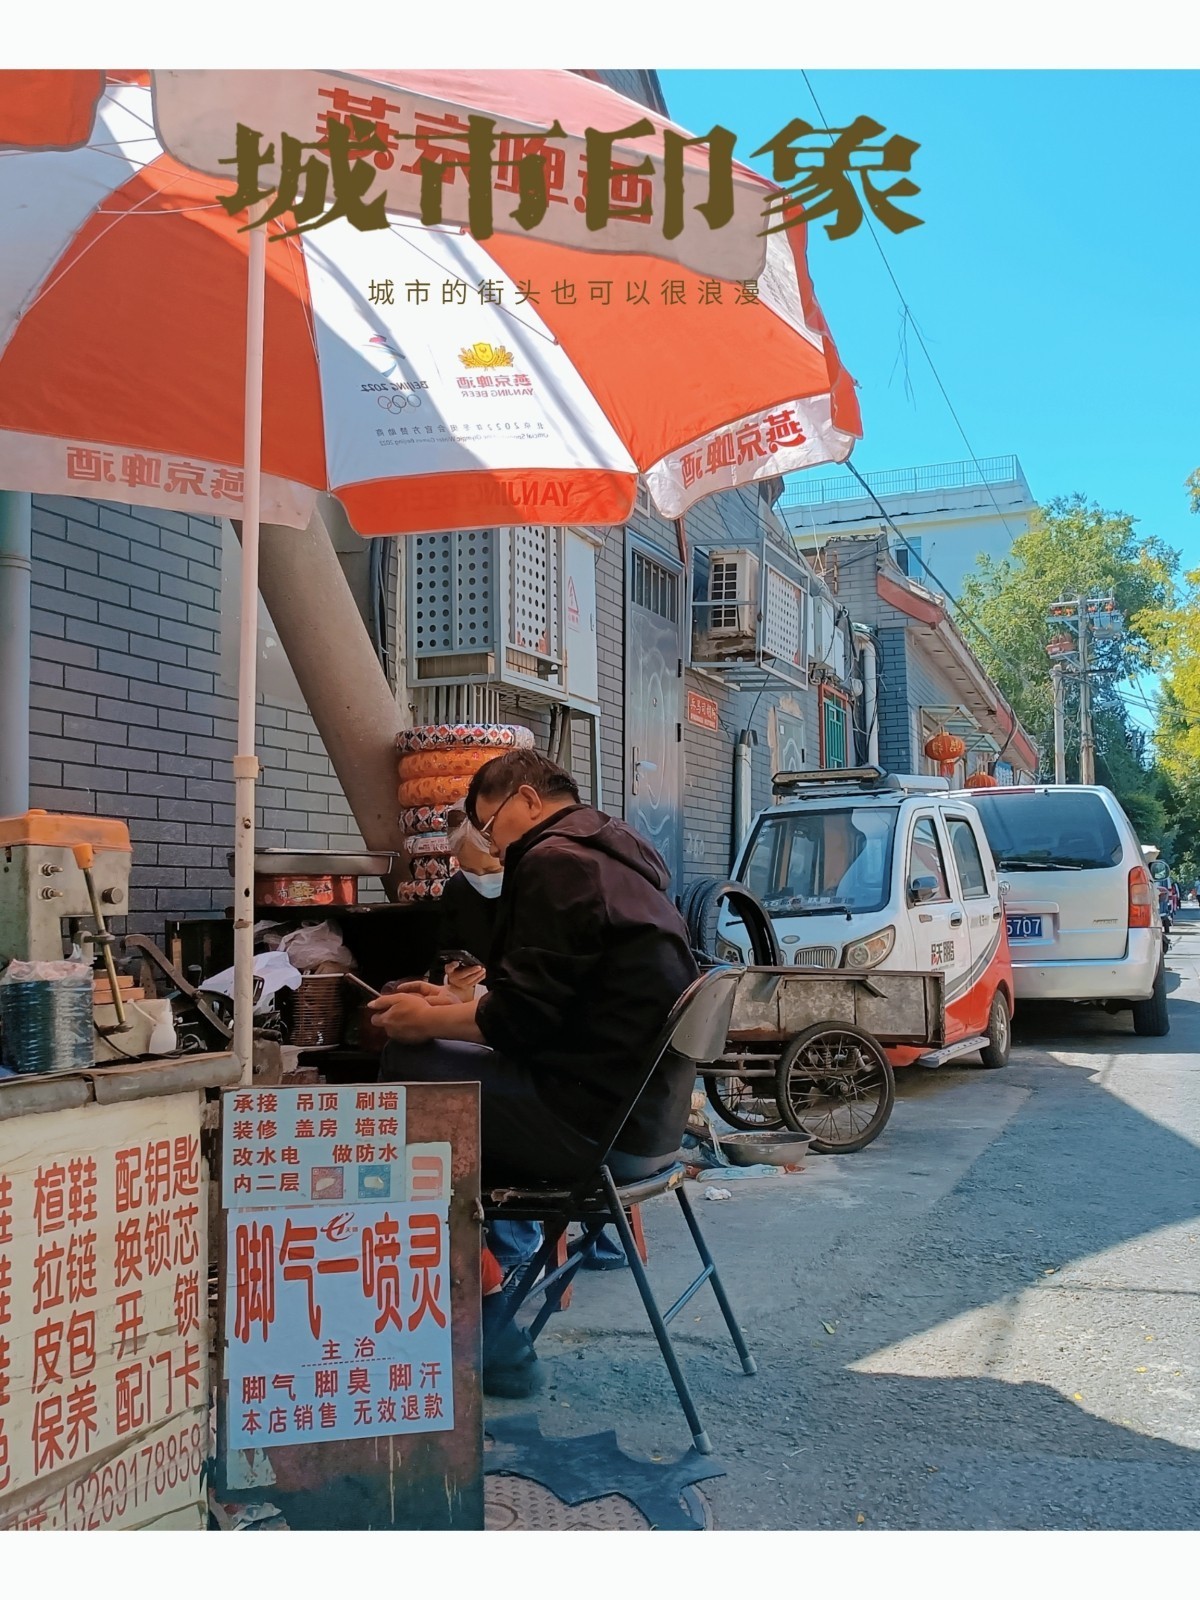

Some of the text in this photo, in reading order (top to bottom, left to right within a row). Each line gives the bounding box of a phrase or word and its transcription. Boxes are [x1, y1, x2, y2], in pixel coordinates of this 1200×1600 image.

[233, 1091, 398, 1113] 承接 吊顶 刷墙
[233, 1117, 398, 1140] 装修 盖房 墙砖
[114, 1134, 199, 1213] 配钥匙
[233, 1143, 398, 1166] 改水电 做防水
[234, 1172, 300, 1193] 内二层
[33, 1228, 97, 1315] 拉链
[114, 1202, 199, 1288] 换锁芯
[235, 1211, 447, 1344] 脚气一喷灵
[32, 1309, 96, 1395] 皮包
[322, 1336, 376, 1360] 主治
[242, 1362, 442, 1404] 脚气 脚臭 脚汗
[32, 1380, 97, 1476] 保养
[115, 1339, 200, 1435] 配门卡
[241, 1392, 444, 1435] 本店销售 无效退款
